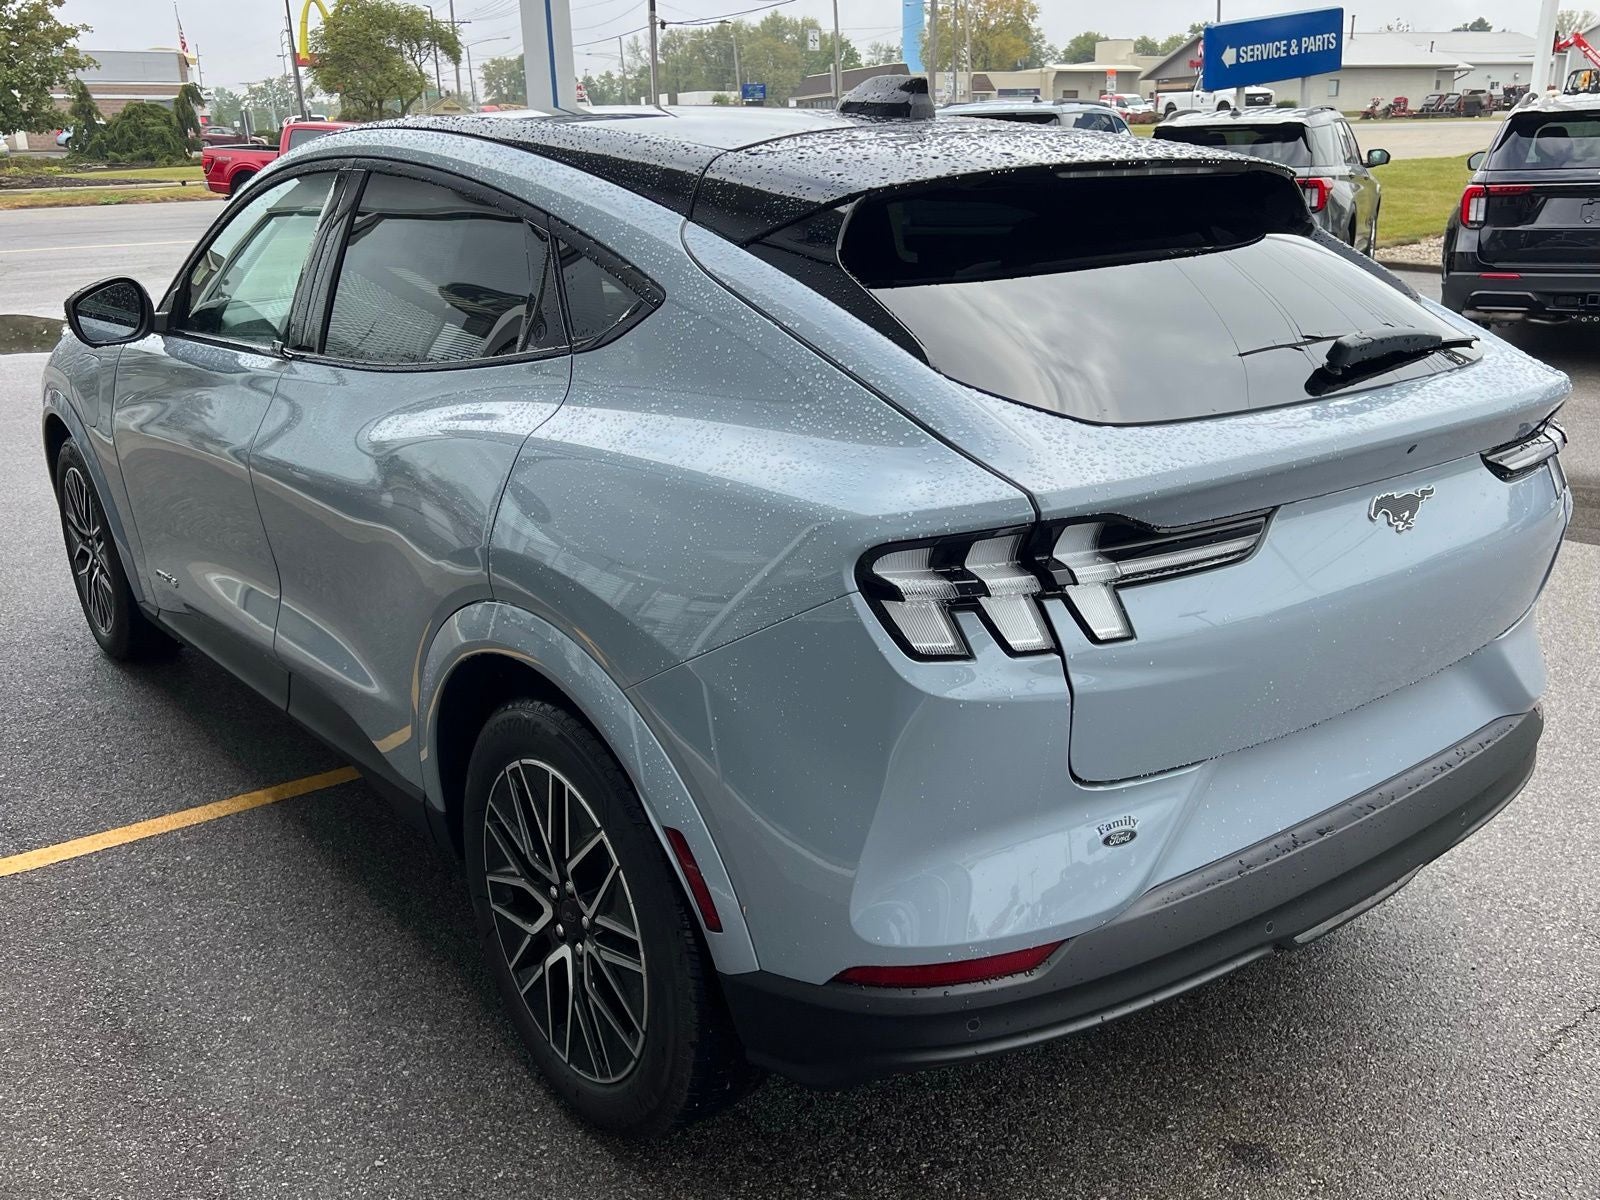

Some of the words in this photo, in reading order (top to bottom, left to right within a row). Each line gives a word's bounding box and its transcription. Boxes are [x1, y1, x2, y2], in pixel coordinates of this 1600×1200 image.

[1239, 40, 1287, 64] SERVICE
[1289, 39, 1299, 56] &
[1301, 32, 1337, 54] PARTS
[1096, 815, 1139, 835] Family
[1109, 831, 1131, 846] Ford
